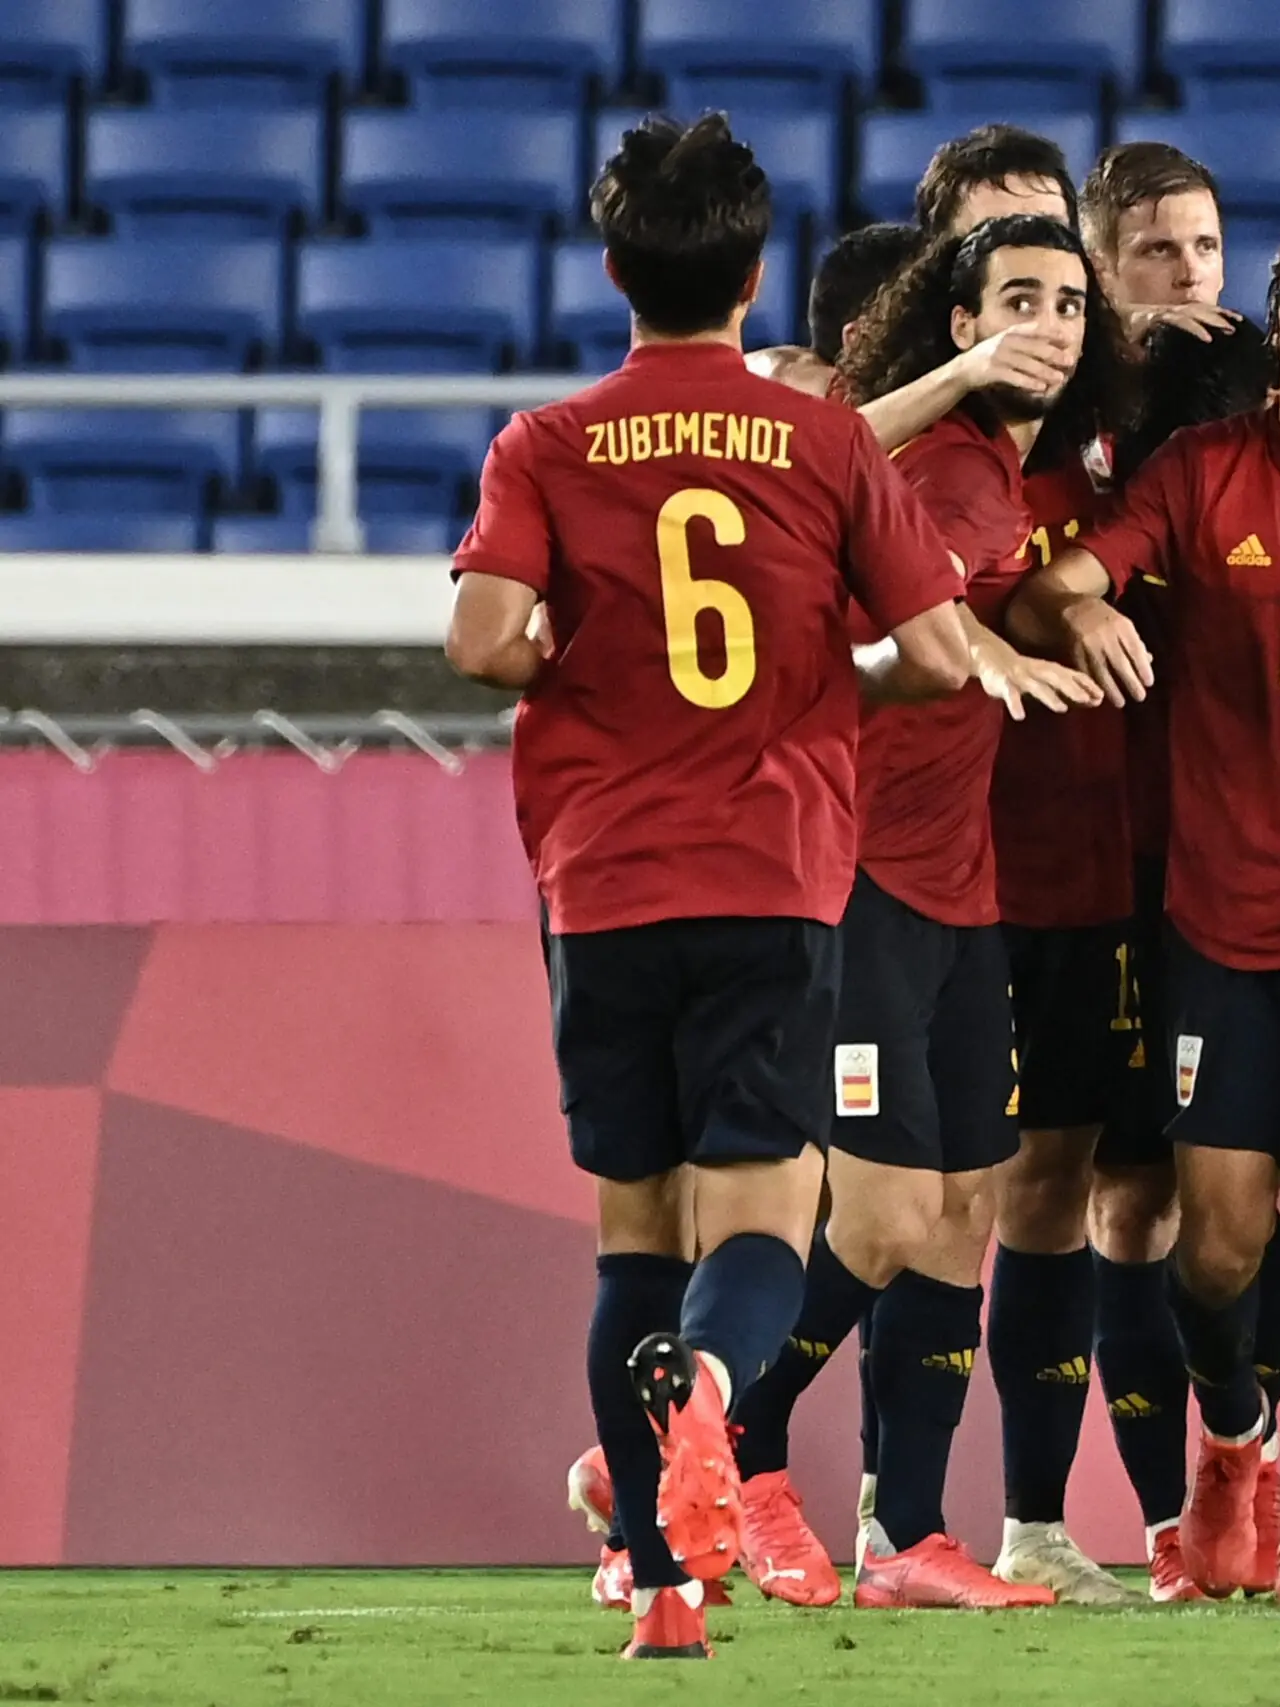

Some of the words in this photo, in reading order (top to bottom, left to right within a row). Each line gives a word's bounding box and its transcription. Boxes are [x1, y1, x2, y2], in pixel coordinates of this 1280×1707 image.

[585, 412, 795, 469] ZUBIMENDI
[1226, 555, 1272, 567] adidas
[656, 488, 757, 710] 6
